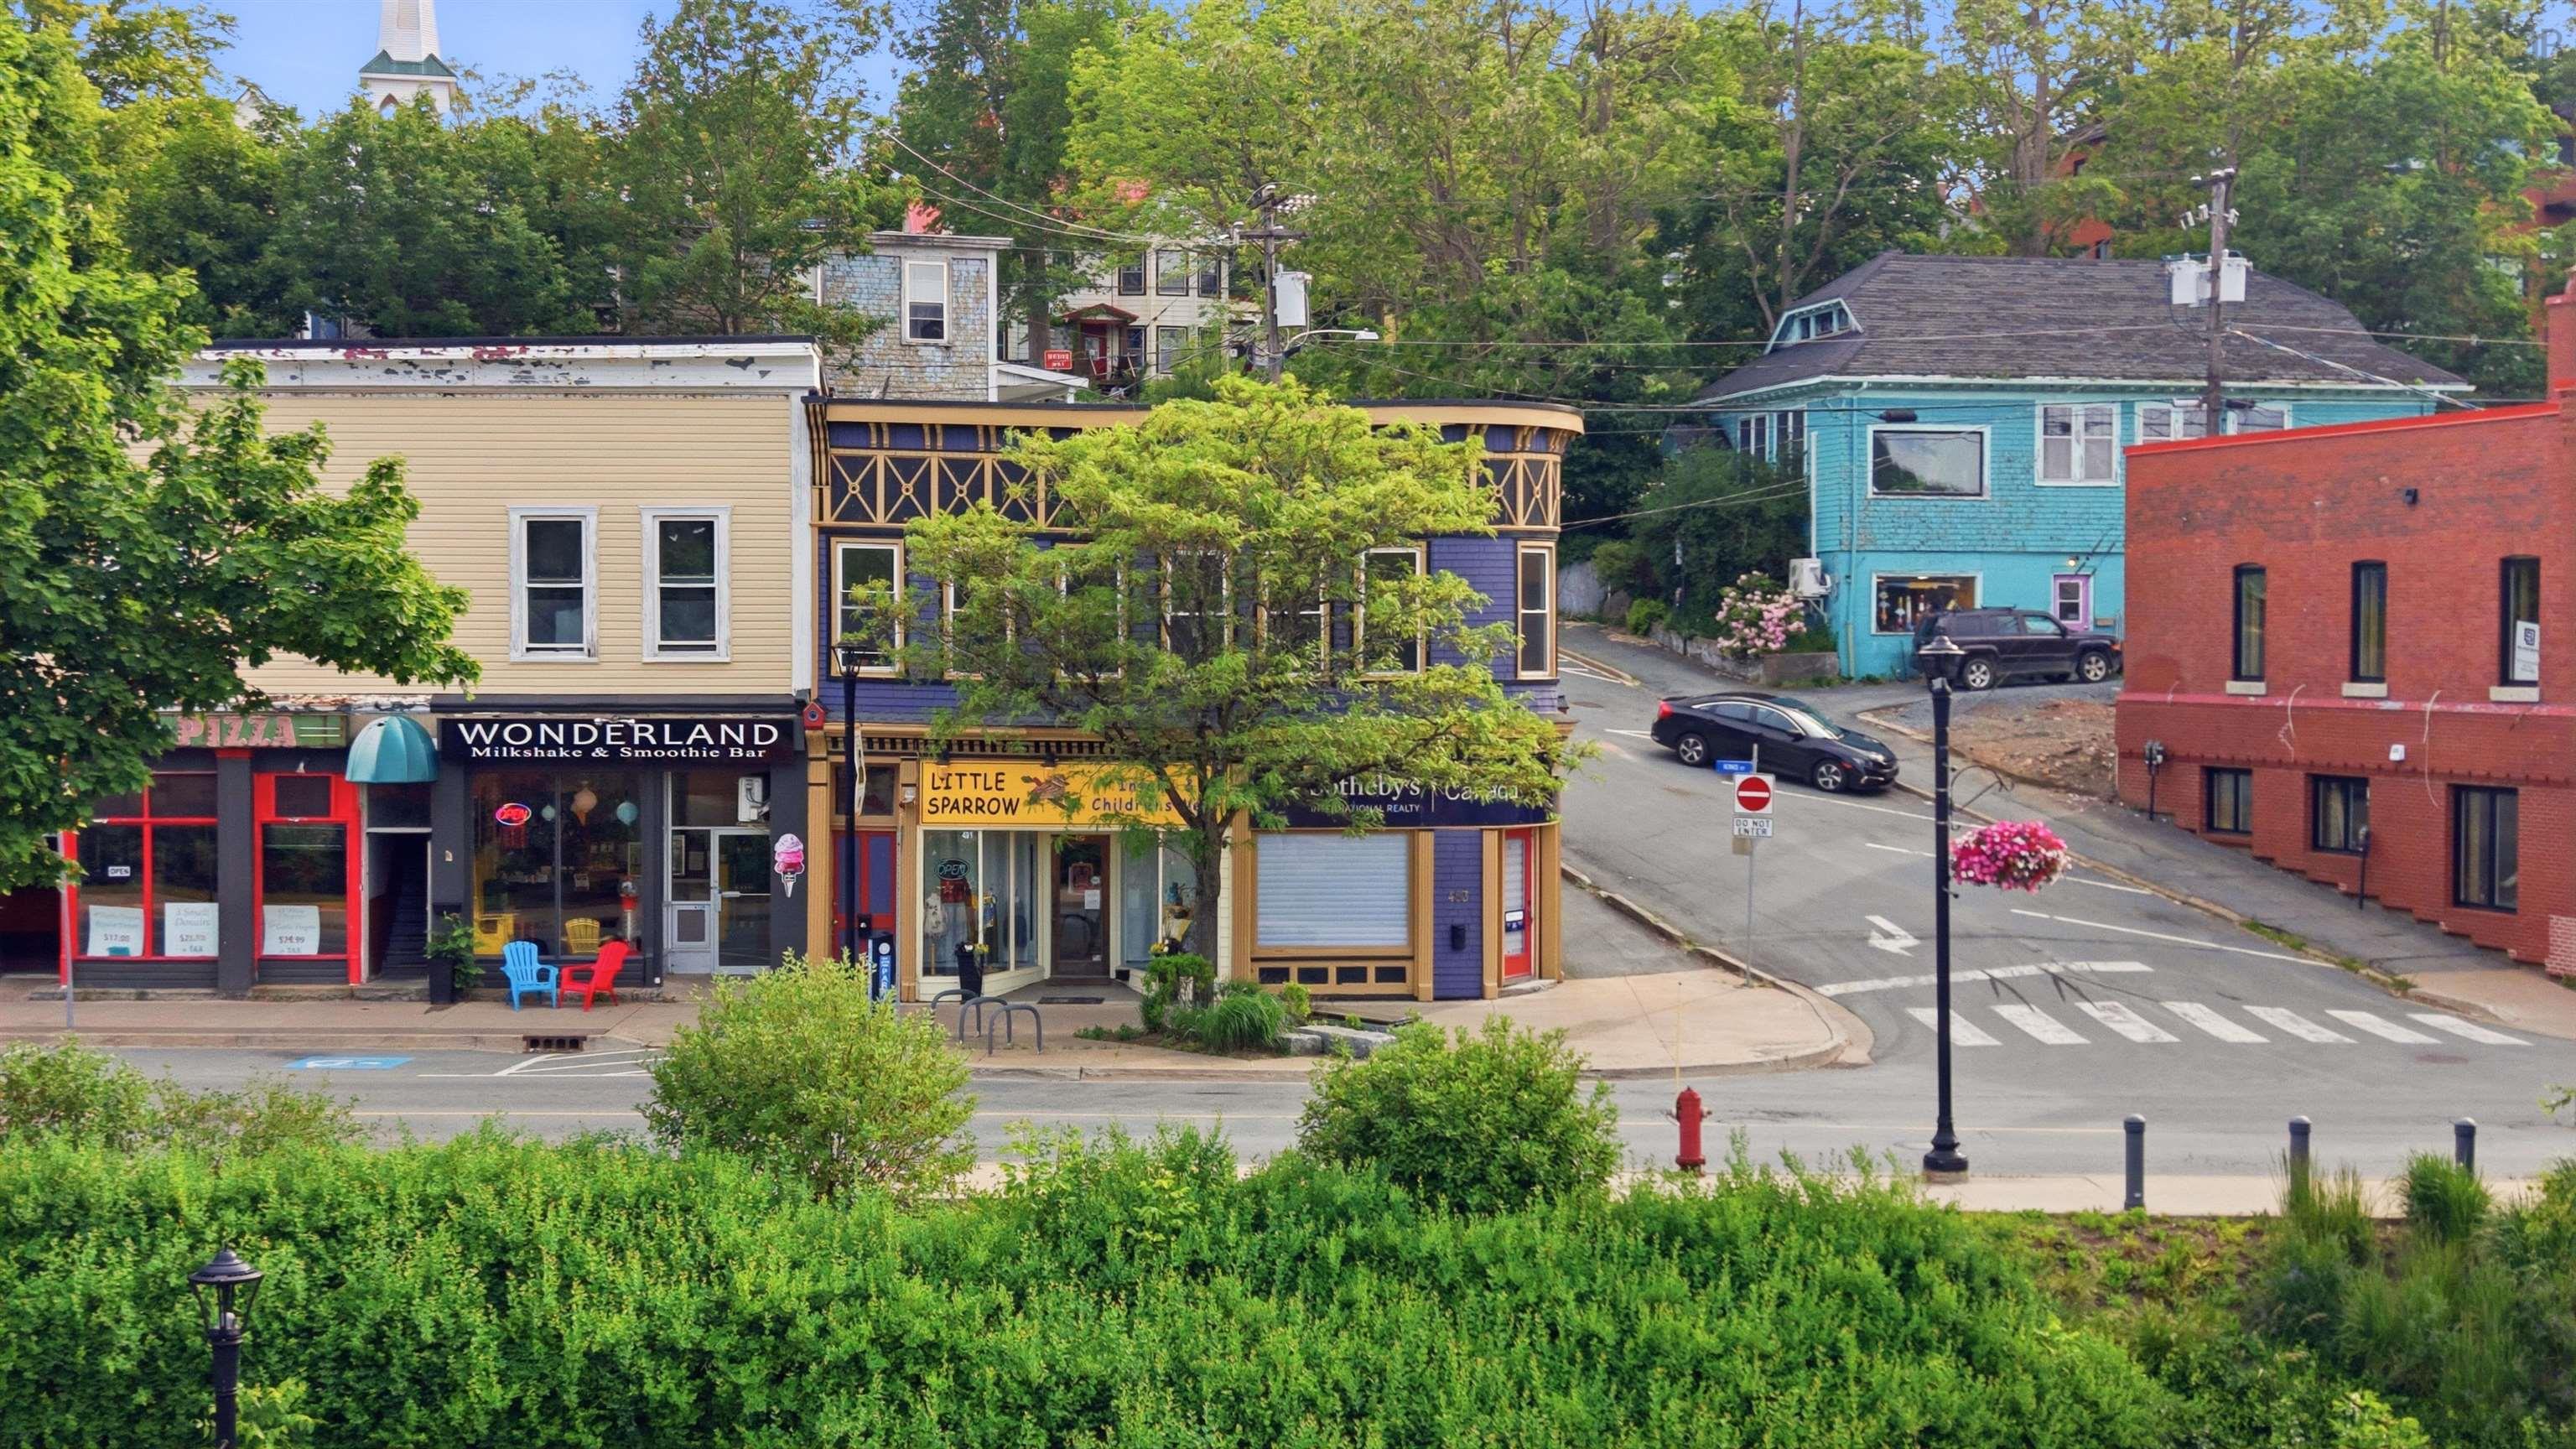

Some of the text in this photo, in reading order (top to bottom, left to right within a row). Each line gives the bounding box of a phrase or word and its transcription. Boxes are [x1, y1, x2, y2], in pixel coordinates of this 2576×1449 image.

[177, 716, 296, 746] PIZZA
[458, 723, 779, 745] WONDERLAND
[471, 746, 766, 758] Milkshake & Smoothie Bar
[932, 771, 1006, 792] LITTLE
[927, 797, 1021, 815] SPARROW
[1387, 804, 1420, 813] REALTY
[938, 864, 967, 875] OPEN
